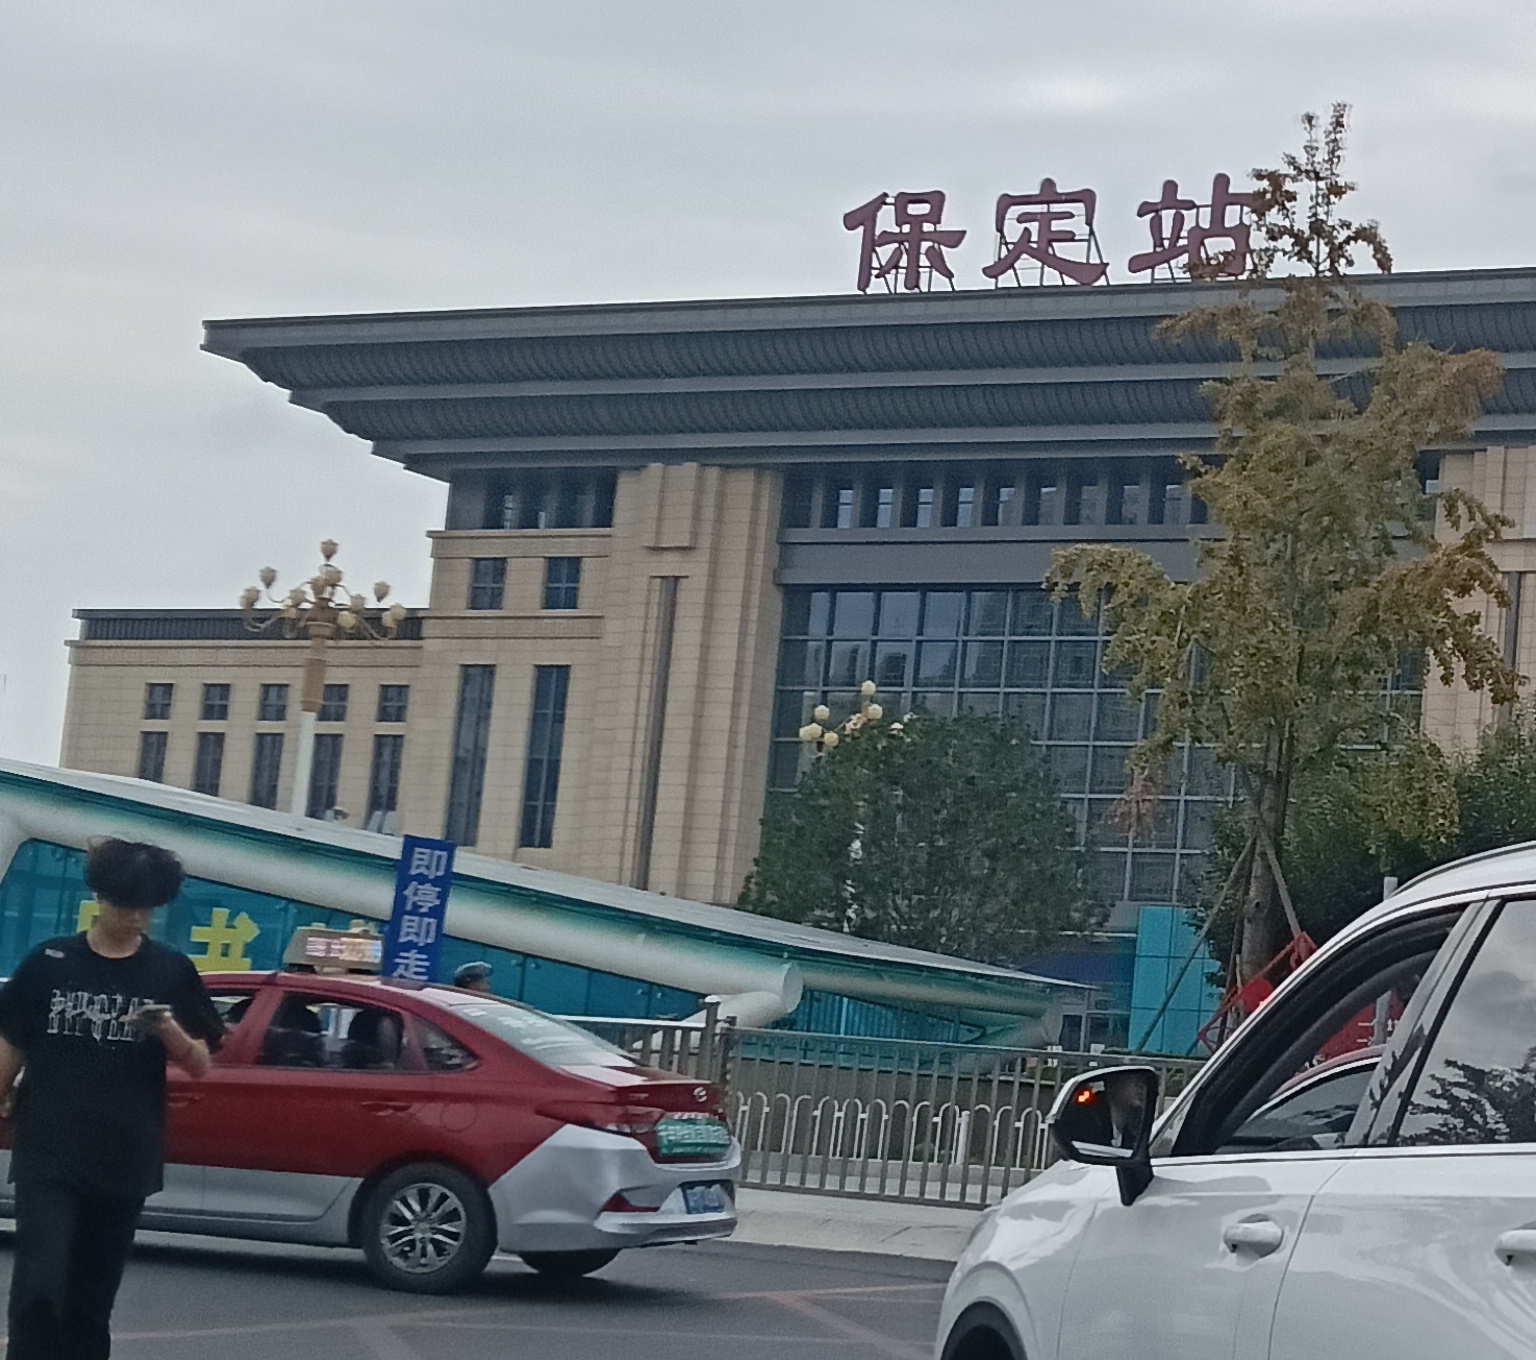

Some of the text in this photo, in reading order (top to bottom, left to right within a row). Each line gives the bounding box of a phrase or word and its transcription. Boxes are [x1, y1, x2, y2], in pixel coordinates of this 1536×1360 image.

[843, 172, 1262, 293] 保定站
[391, 847, 448, 981] 即停即走
